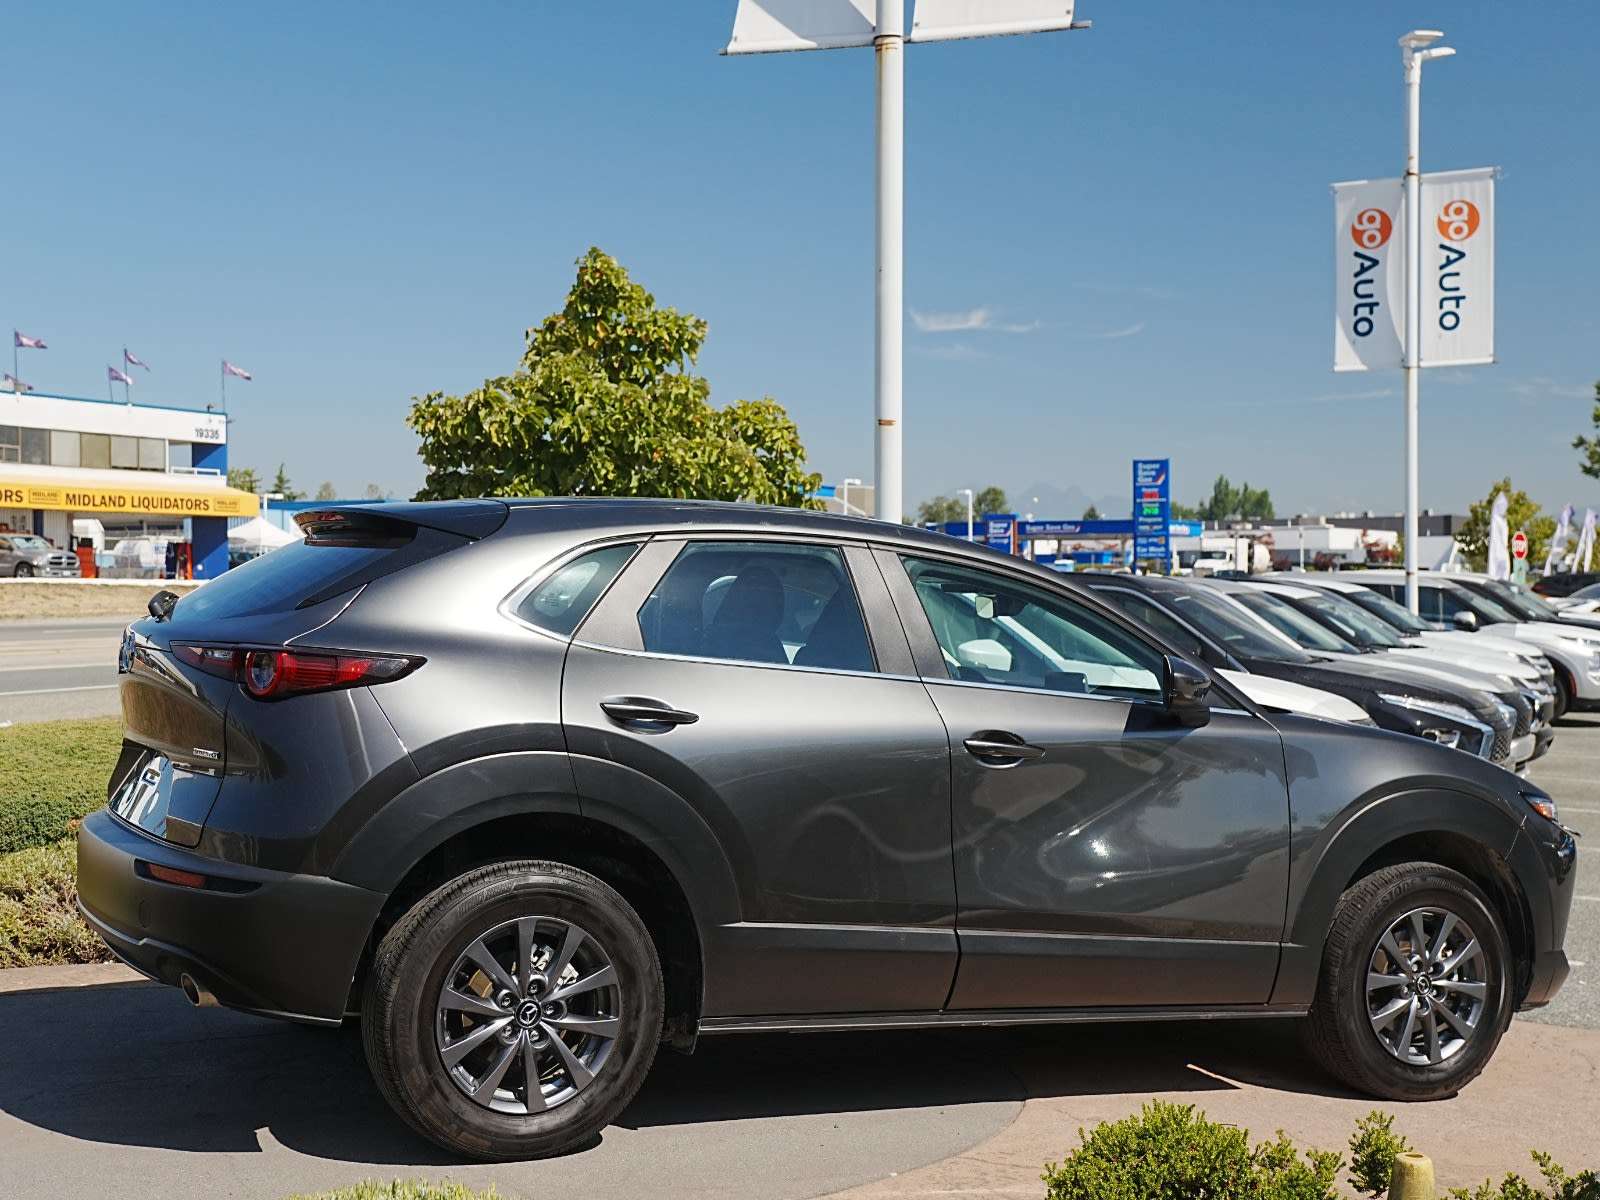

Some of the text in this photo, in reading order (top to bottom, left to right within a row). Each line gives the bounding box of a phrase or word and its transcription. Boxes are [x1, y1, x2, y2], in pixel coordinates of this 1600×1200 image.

[1353, 251, 1380, 337] Auto
[1438, 244, 1466, 331] Auto
[0, 488, 23, 503] RS
[65, 492, 210, 511] MIDLAND LIQUIDATORS
